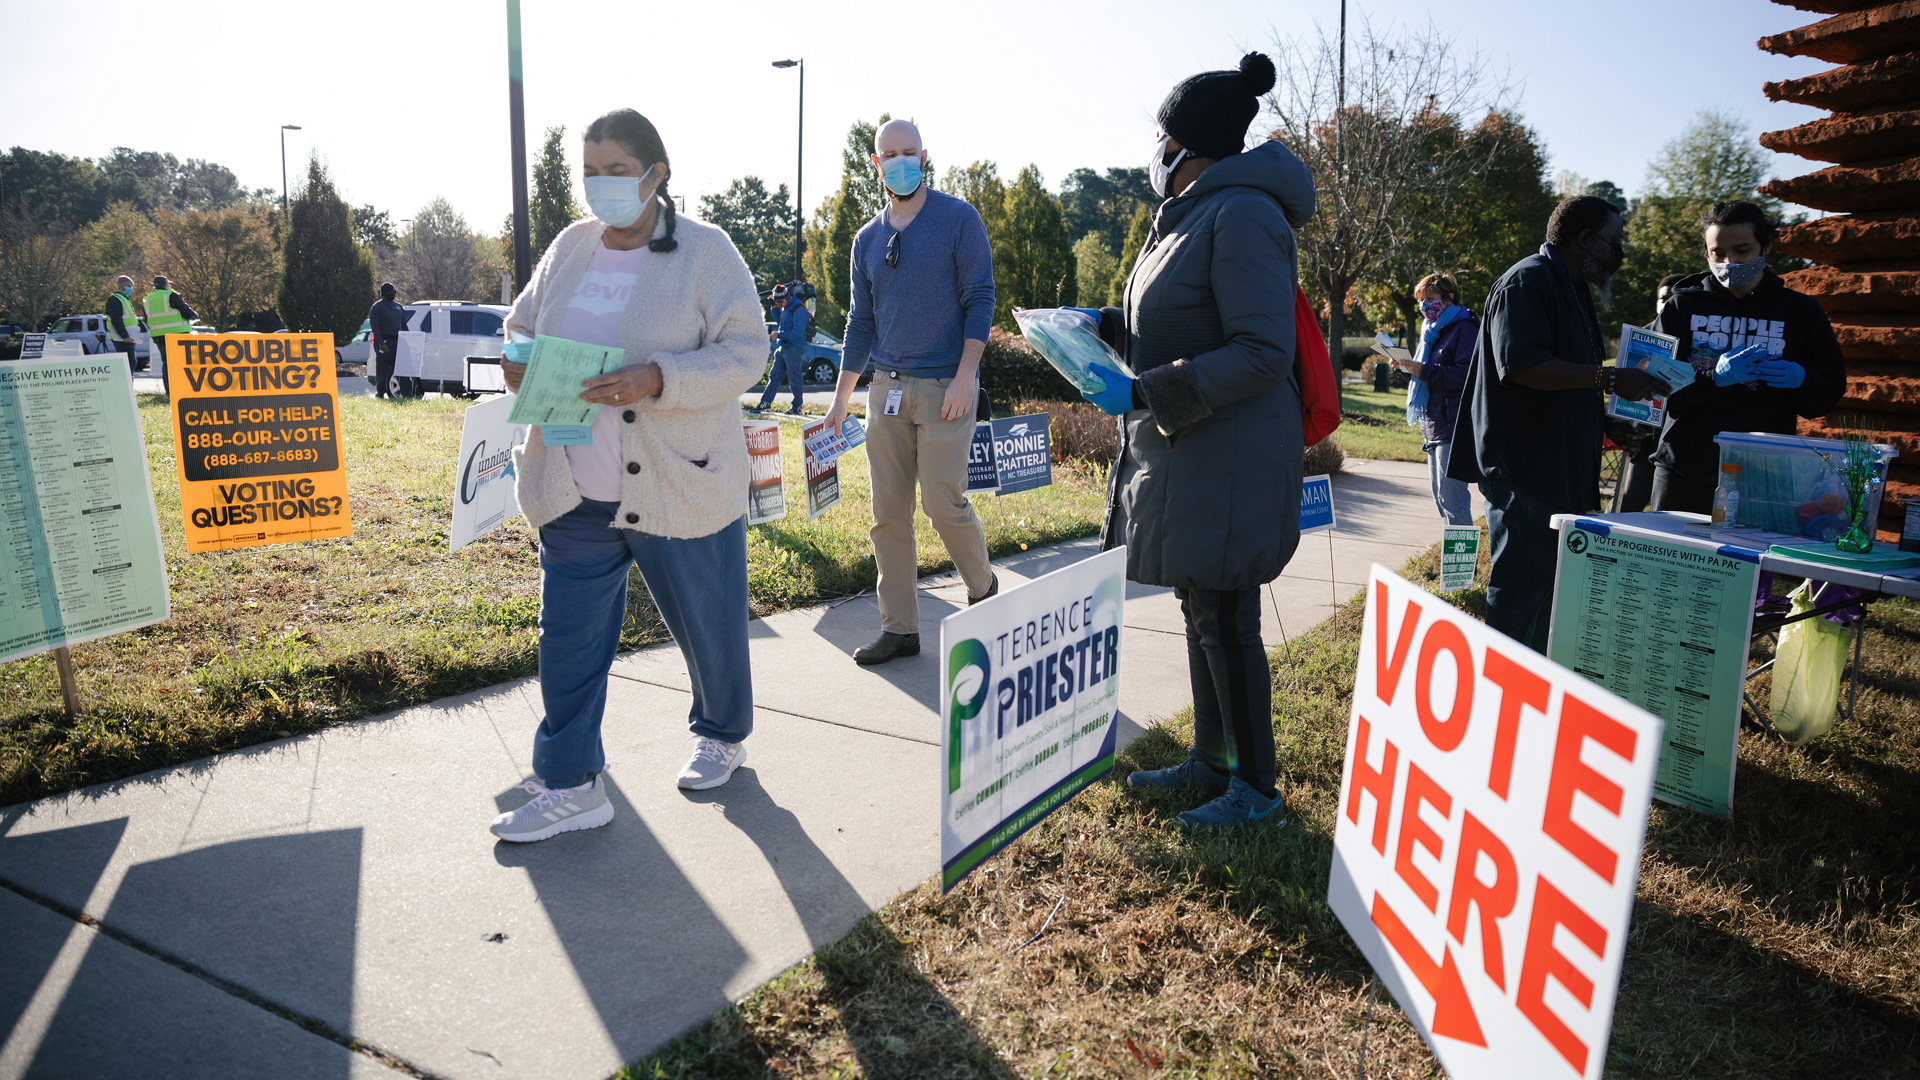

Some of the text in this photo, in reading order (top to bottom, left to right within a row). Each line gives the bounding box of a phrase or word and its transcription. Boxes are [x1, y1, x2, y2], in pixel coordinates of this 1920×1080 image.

[1690, 314, 1785, 338] PEOPLE
[178, 339, 318, 365] TROUBLE
[1632, 333, 1655, 344] JILLIAN
[1657, 339, 1674, 350] RILEY
[41, 369, 72, 378] WITH
[75, 368, 88, 376] PA
[91, 366, 111, 374] PAC
[184, 365, 321, 392] VOTING?
[185, 406, 328, 426] CALL FOR HELP:
[188, 427, 331, 449] 888-OUR-VOTE
[748, 432, 772, 448] ROBERT
[995, 434, 1045, 458] RONNIE
[204, 448, 318, 470] (888-687-8683)
[968, 466, 994, 474] EUTENANT
[997, 452, 1046, 472] CHATTERJI
[1016, 465, 1046, 478] TREASURER
[219, 478, 315, 504] VOTING
[192, 496, 342, 528] QUESTIONS?
[1594, 535, 1741, 570] VOTE PROGRESSIVE WITH PA PAC
[997, 595, 1093, 667] TERENCE
[997, 624, 1118, 740] PRIESTER
[1376, 580, 1638, 887] VOTE
[955, 712, 1109, 820] better COMMUNITY better DURHAM better PROGRESS
[991, 777, 1083, 848] PAID FOR BY TERENCE FOR DURHAM
[1346, 714, 1608, 1078] HERE
